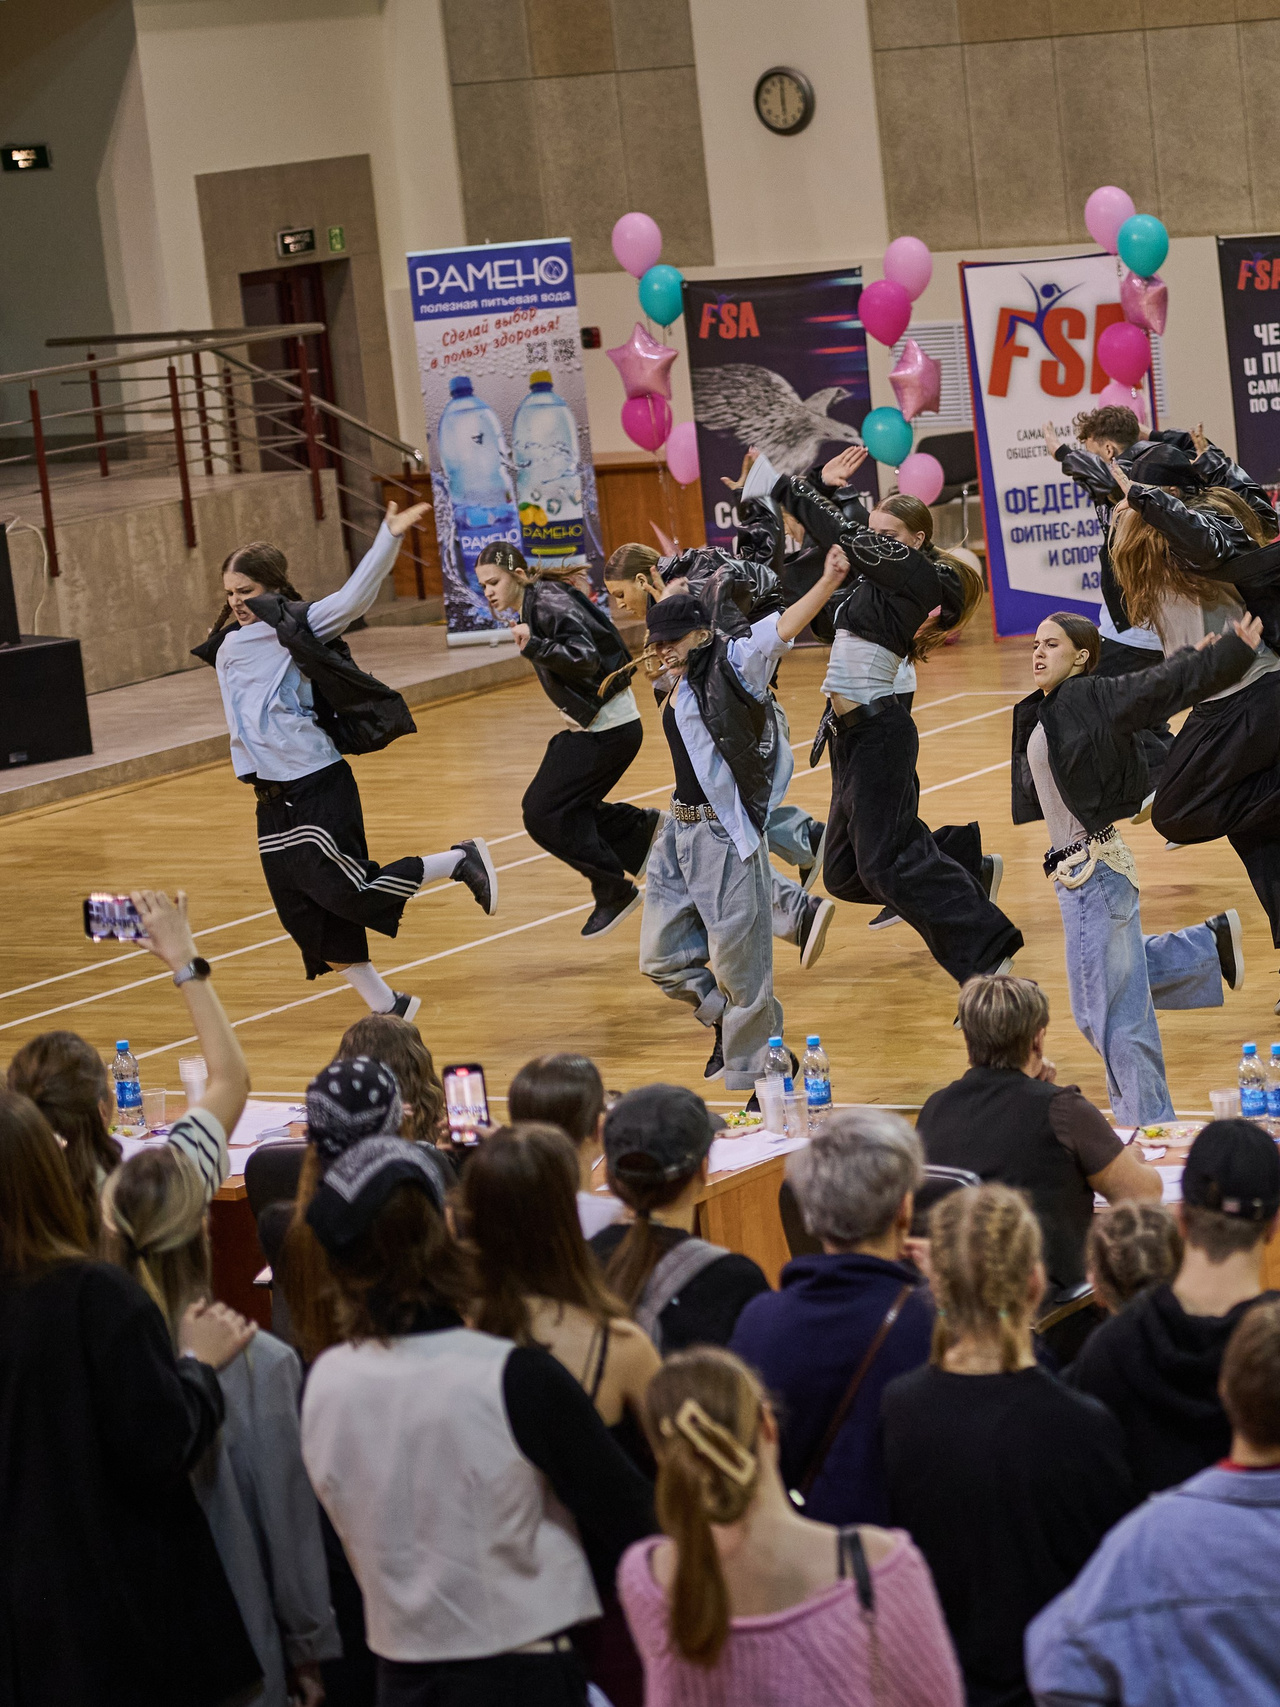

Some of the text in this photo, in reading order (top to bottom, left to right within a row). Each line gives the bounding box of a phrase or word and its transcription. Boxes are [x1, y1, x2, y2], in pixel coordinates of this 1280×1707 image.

[416, 256, 568, 296] РАМЕНО
[420, 291, 571, 314] полезная питьевая вода
[699, 301, 760, 339] FSA
[430, 316, 560, 369] в пользу здоровья!
[442, 306, 539, 347] Сделай выбор
[1249, 397, 1268, 413] ПО
[1004, 482, 1094, 515] ФЕДЕР
[1049, 550, 1059, 567] И
